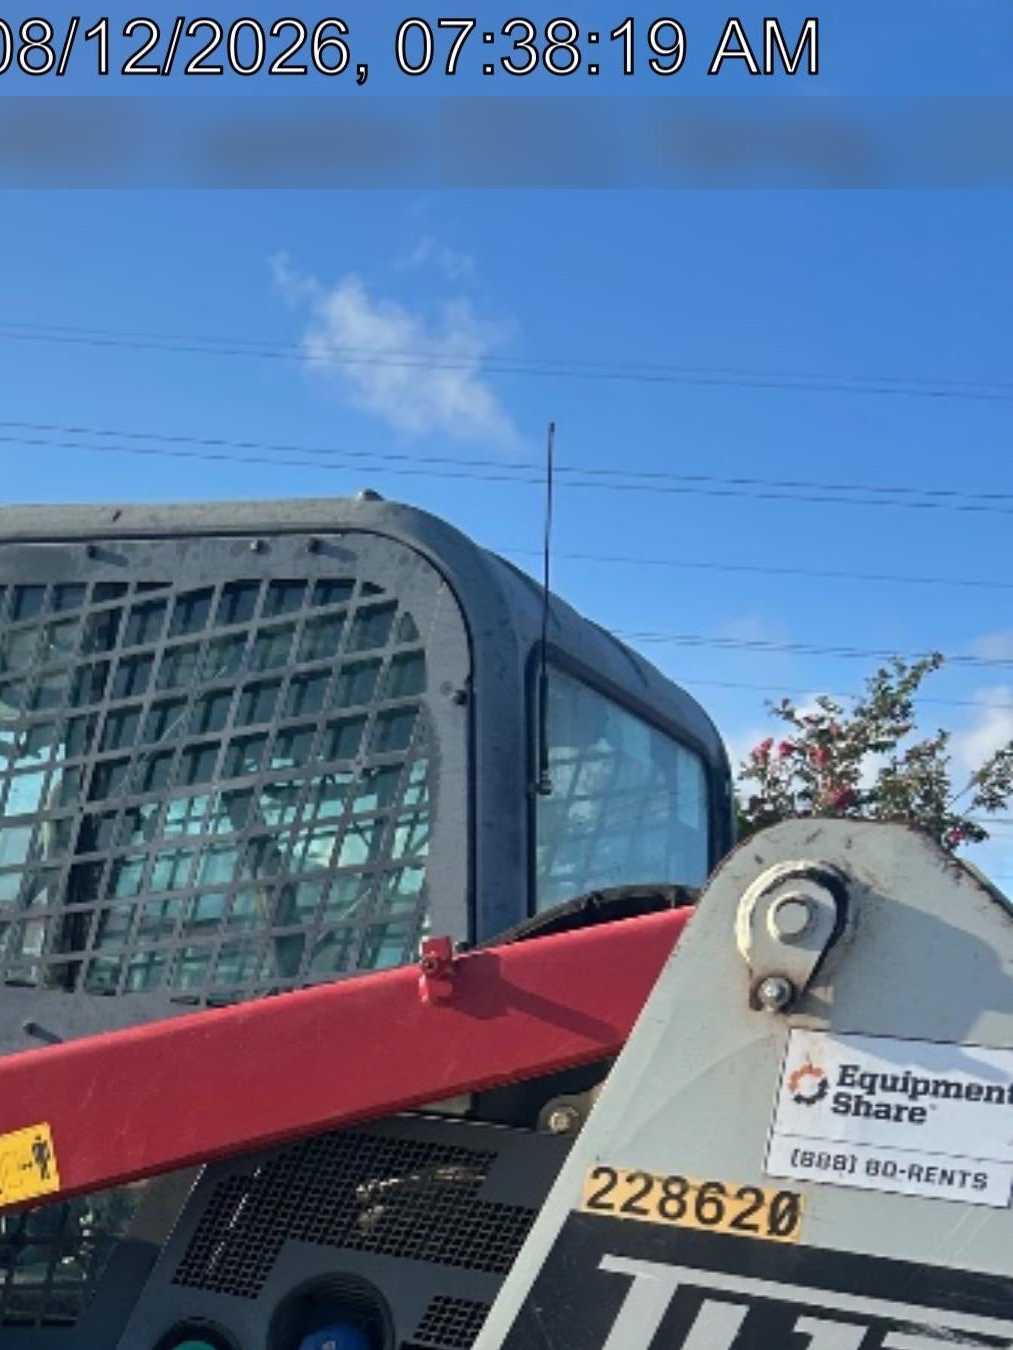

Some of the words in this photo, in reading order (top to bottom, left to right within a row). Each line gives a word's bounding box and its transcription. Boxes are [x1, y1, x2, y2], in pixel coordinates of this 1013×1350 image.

[831, 1092, 928, 1124] Share
[790, 1148, 858, 1174] (888)
[865, 1158, 989, 1192] 80-RENTS
[586, 1165, 801, 1237] 228620
